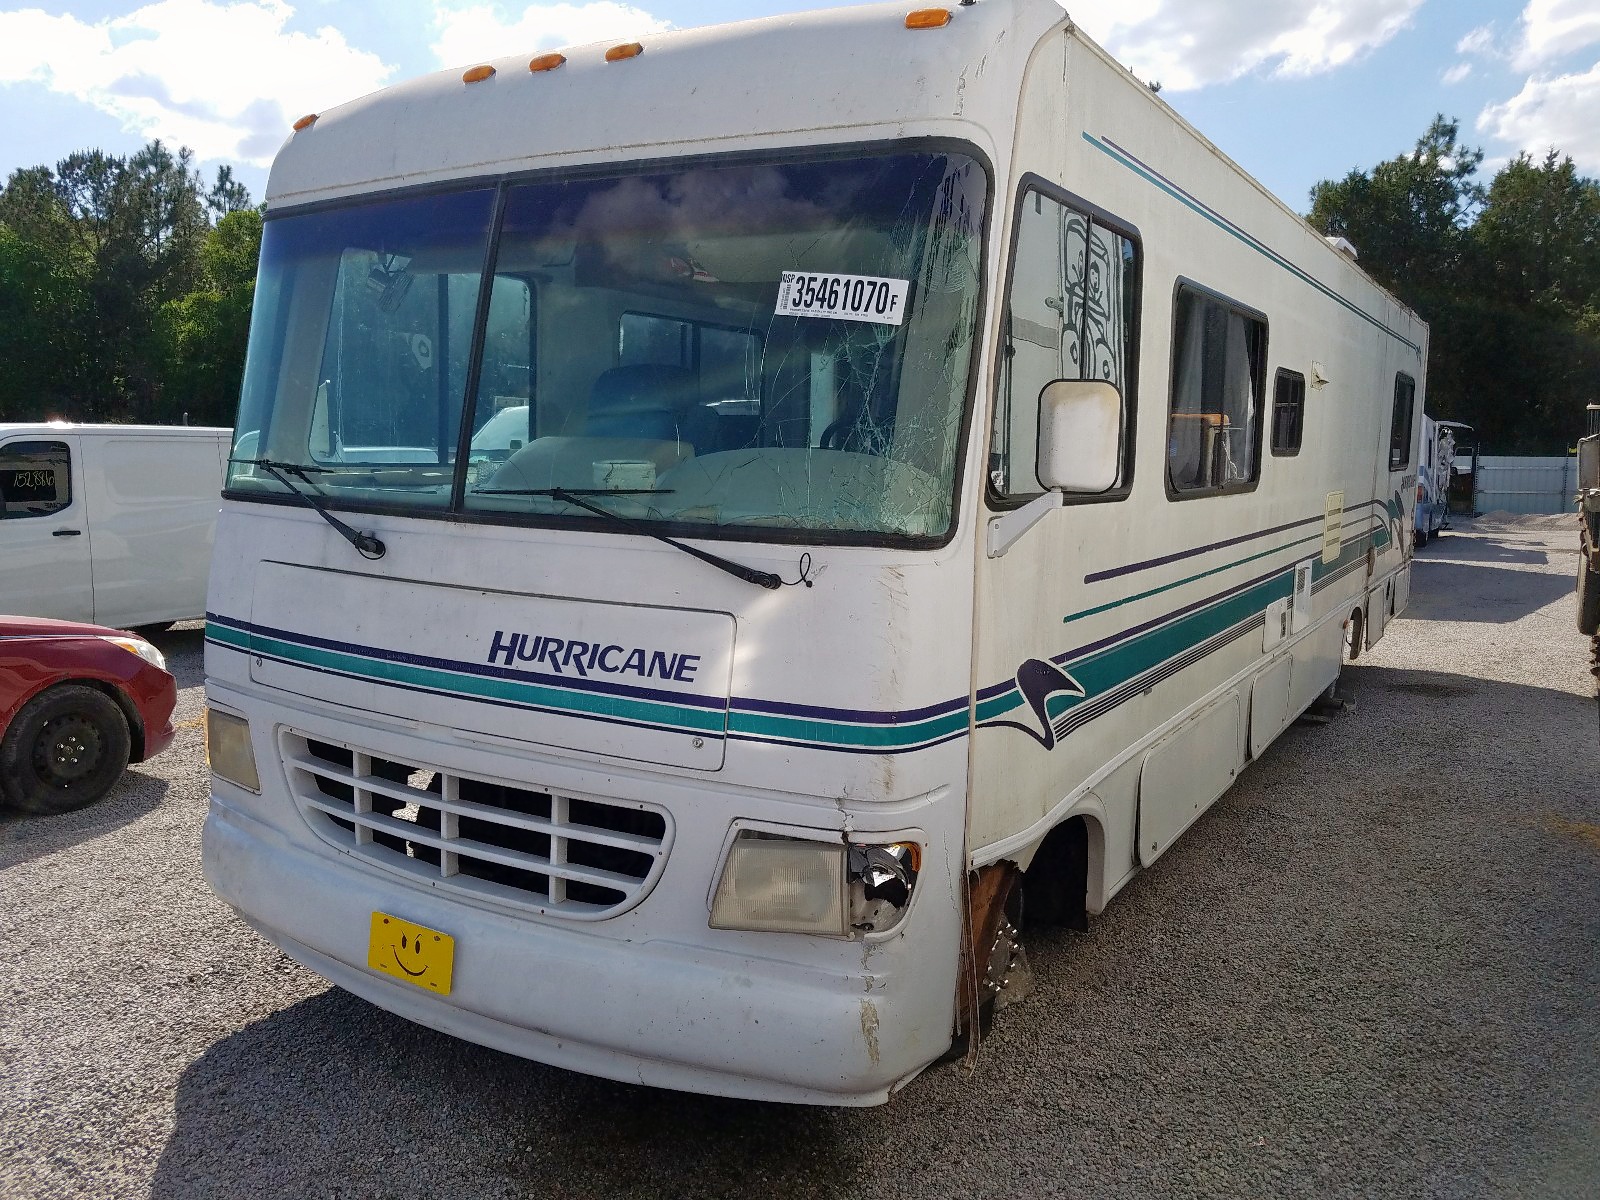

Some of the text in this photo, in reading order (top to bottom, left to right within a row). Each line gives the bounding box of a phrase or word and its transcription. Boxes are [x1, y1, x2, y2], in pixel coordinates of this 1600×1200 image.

[792, 275, 890, 315] 35461070
[890, 294, 898, 312] F
[487, 630, 701, 683] HURRICANE
